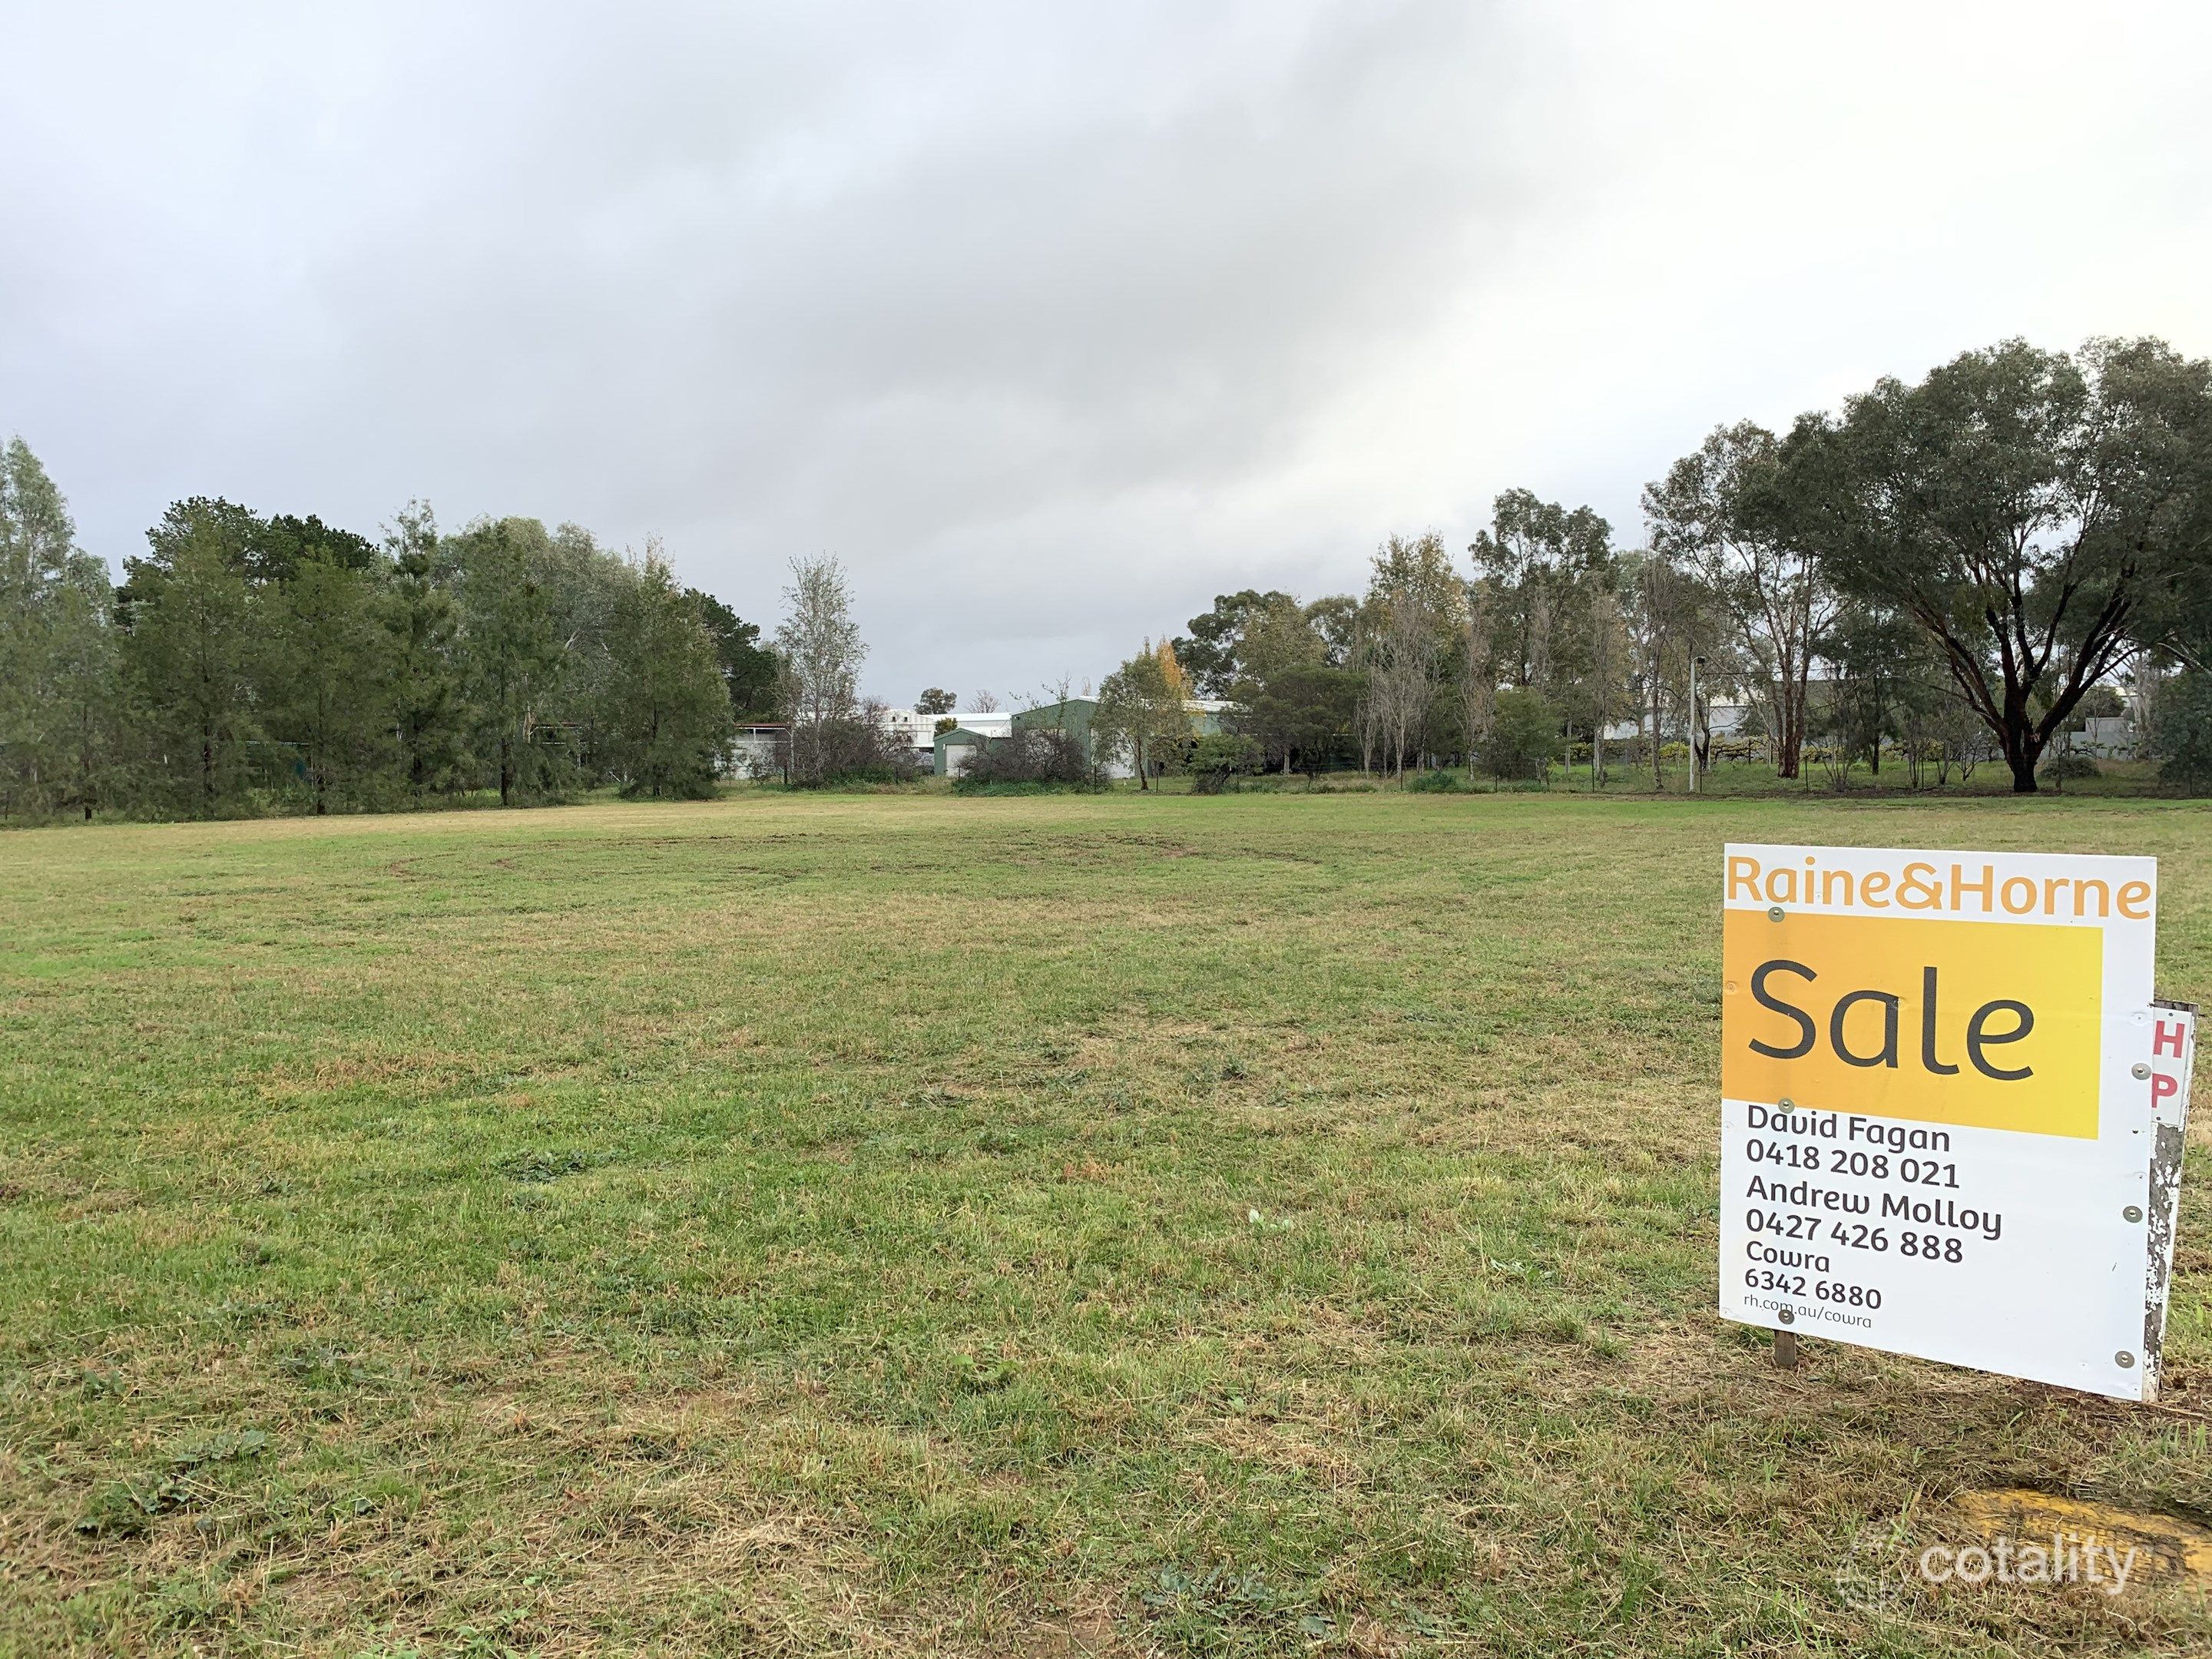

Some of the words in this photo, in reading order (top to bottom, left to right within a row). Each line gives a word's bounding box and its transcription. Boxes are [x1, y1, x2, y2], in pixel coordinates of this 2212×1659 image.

[1727, 856, 2151, 919] Raine&Horne
[1748, 959, 2035, 1081] Sale
[1747, 1104, 1837, 1138] David
[1849, 1116, 1950, 1154] Fagan
[1746, 1138, 1820, 1170] 0418
[1830, 1150, 1889, 1179] 208
[1900, 1158, 1960, 1189] 021
[1746, 1175, 1870, 1214] Andrew
[1881, 1193, 2002, 1241] Molloy
[1746, 1208, 1822, 1241] 0427
[1830, 1221, 1889, 1252] 426
[1900, 1231, 1963, 1263] 888
[1746, 1240, 1830, 1273] Cowra
[1743, 1293, 1872, 1329] rh.com.au/cowra
[1744, 1268, 1806, 1297] 6342
[1815, 1280, 1882, 1310] 6880
